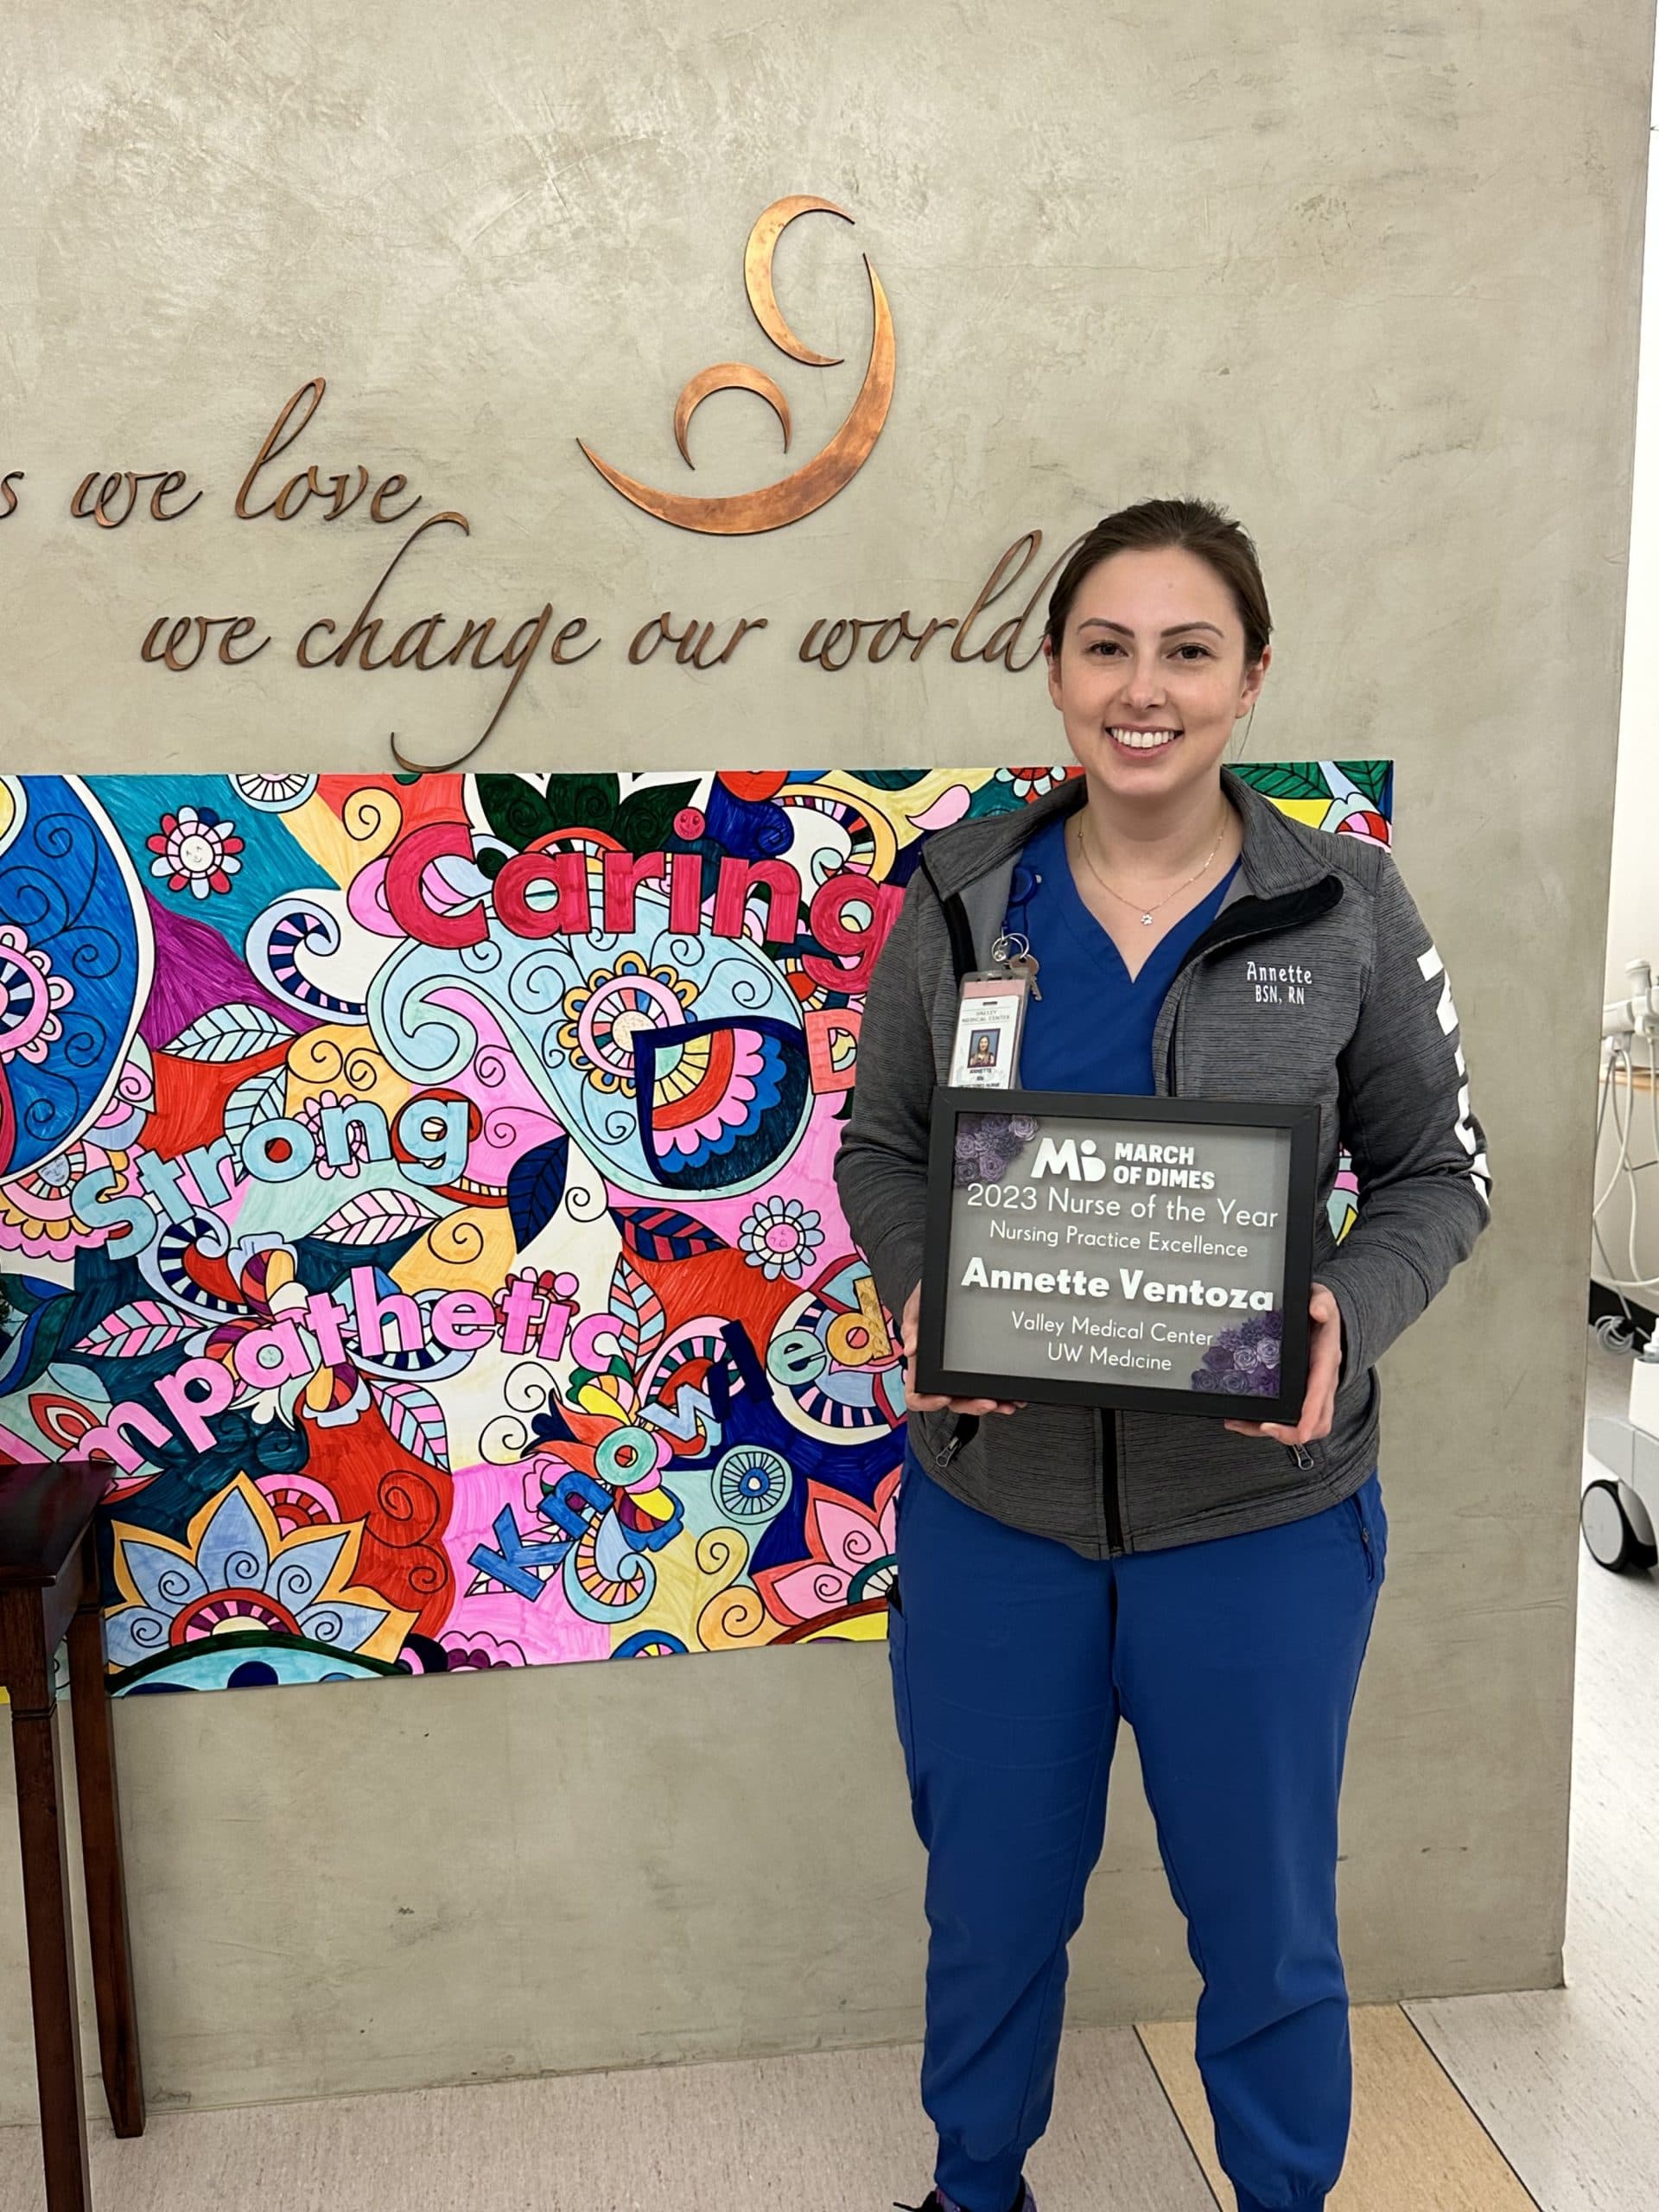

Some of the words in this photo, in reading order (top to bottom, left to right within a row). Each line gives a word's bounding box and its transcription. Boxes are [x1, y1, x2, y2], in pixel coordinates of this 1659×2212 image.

[71, 469, 203, 529] we
[235, 377, 422, 524] love
[141, 614, 270, 671] we
[296, 510, 601, 774] change
[628, 611, 768, 671] our
[798, 528, 1085, 672] world
[384, 807, 907, 995] Caring
[1246, 961, 1313, 984] Annette
[1255, 984, 1283, 1005] BSN,
[1288, 986, 1305, 1004] RN
[1114, 1142, 1195, 1166] MARCH
[70, 1099, 471, 1261] Strong
[1113, 1165, 1142, 1185] OF
[1145, 1167, 1216, 1190] DIMES
[966, 1183, 1038, 1211] 2023
[1047, 1186, 1122, 1217] Nurse
[1130, 1193, 1157, 1219] of
[1166, 1195, 1206, 1223] the
[1217, 1198, 1279, 1228] Year
[989, 1219, 1059, 1247] Nursing
[1065, 1225, 1141, 1249] Practice
[1147, 1231, 1249, 1257] Excellence
[960, 1256, 1110, 1298] Annette
[1119, 1268, 1274, 1311] Ventoza
[1011, 1311, 1065, 1337] Valley
[1071, 1316, 1145, 1340] Medical
[1149, 1322, 1214, 1346] Center
[55, 1265, 626, 1477] mpathetic
[1047, 1342, 1084, 1363] UW
[1089, 1346, 1173, 1371] Medicine
[467, 1274, 895, 1603] Knowled
